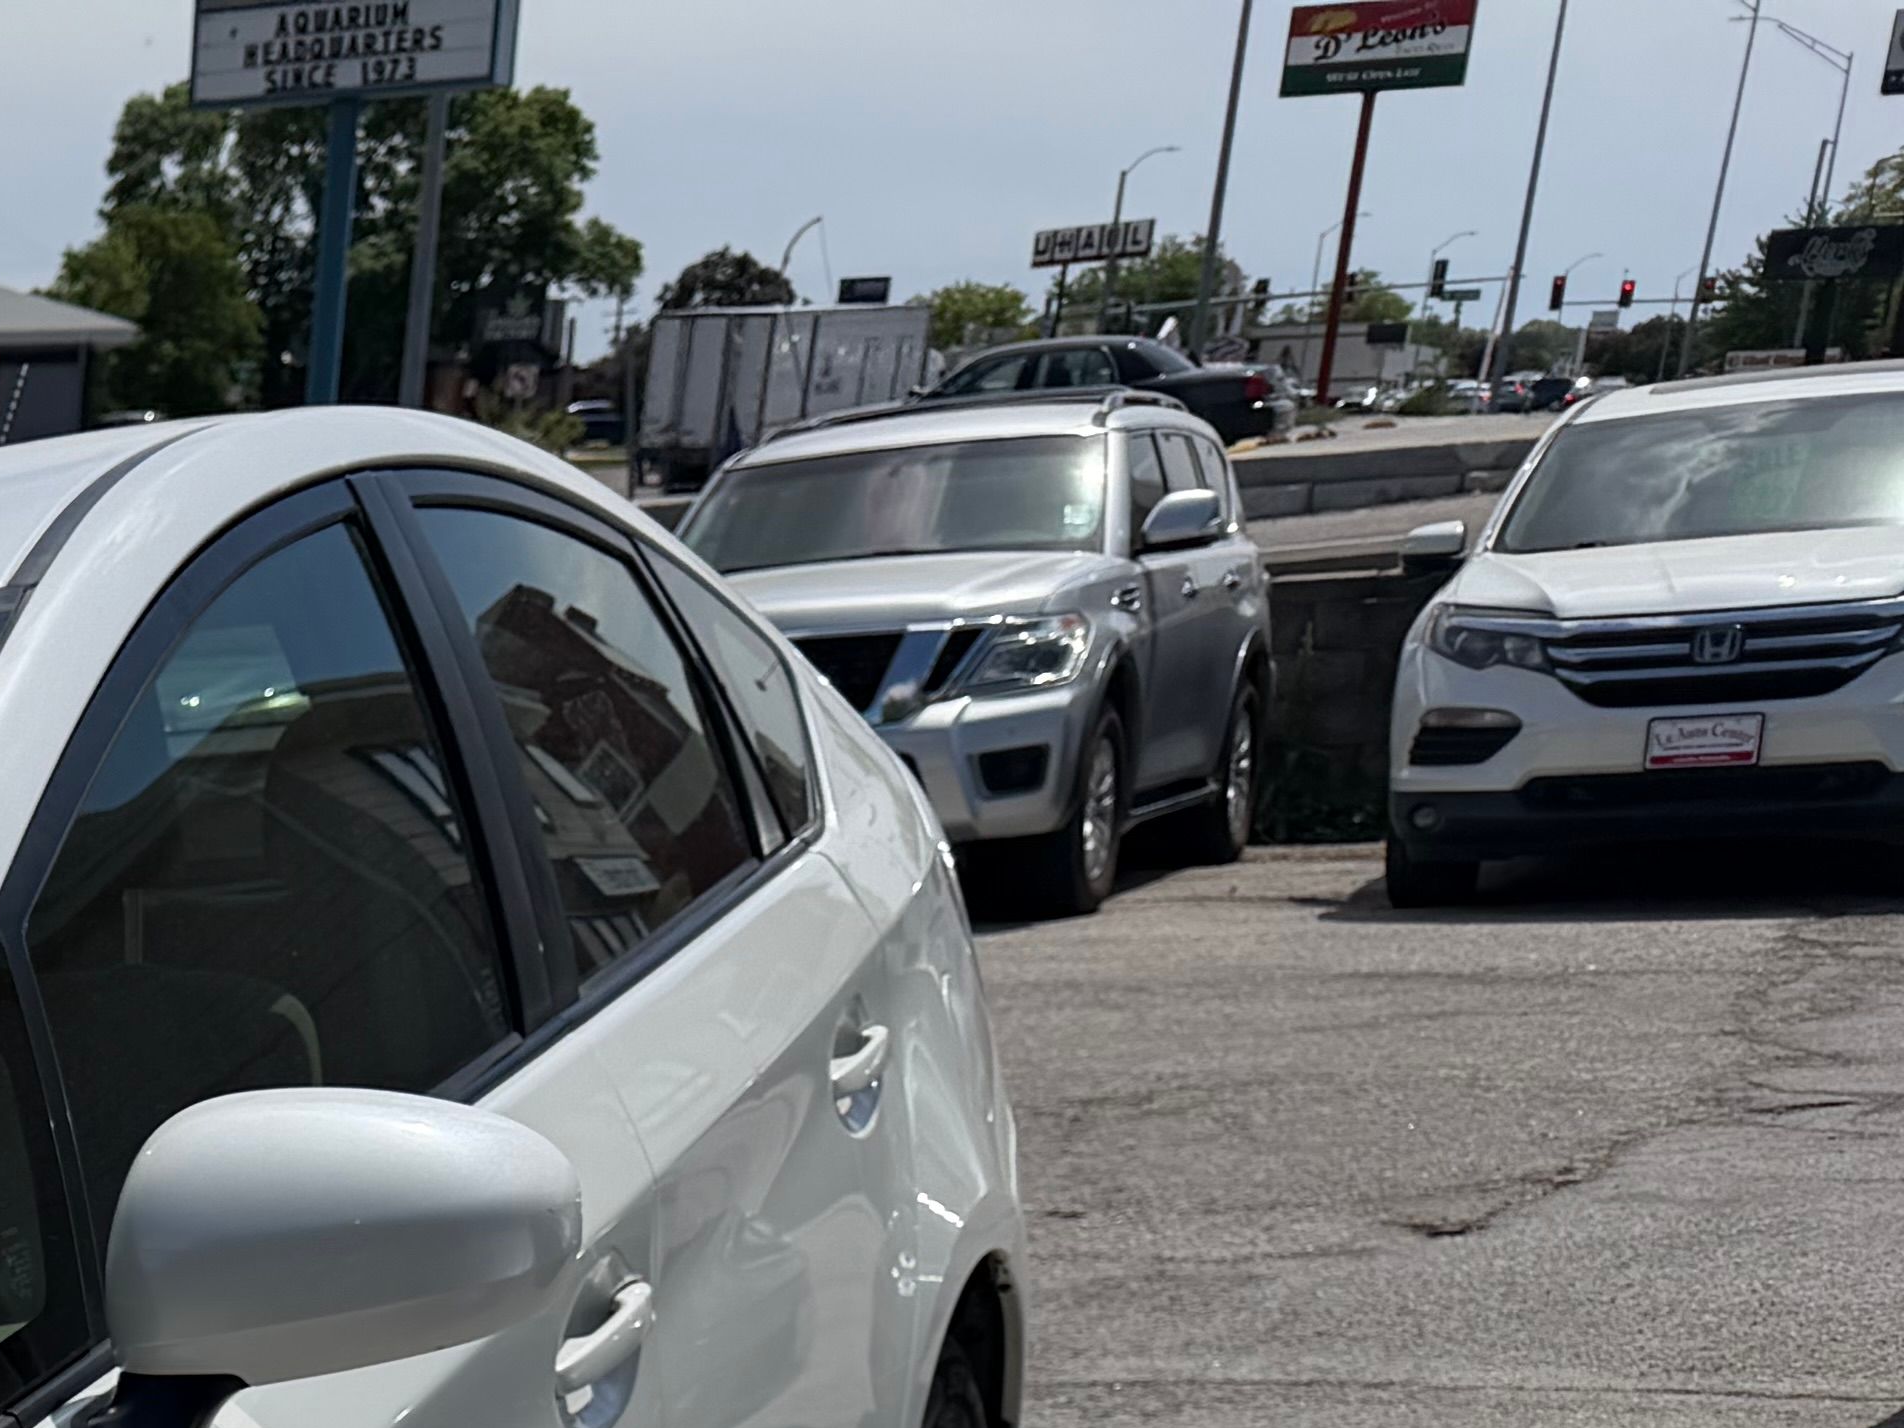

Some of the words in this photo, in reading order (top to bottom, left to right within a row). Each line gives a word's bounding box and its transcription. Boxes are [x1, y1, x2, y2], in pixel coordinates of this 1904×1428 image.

[275, 2, 410, 38] AQUARIUM
[244, 25, 443, 69] HEADQUARTERS
[264, 63, 337, 95] SINCE
[360, 56, 419, 87] 1973
